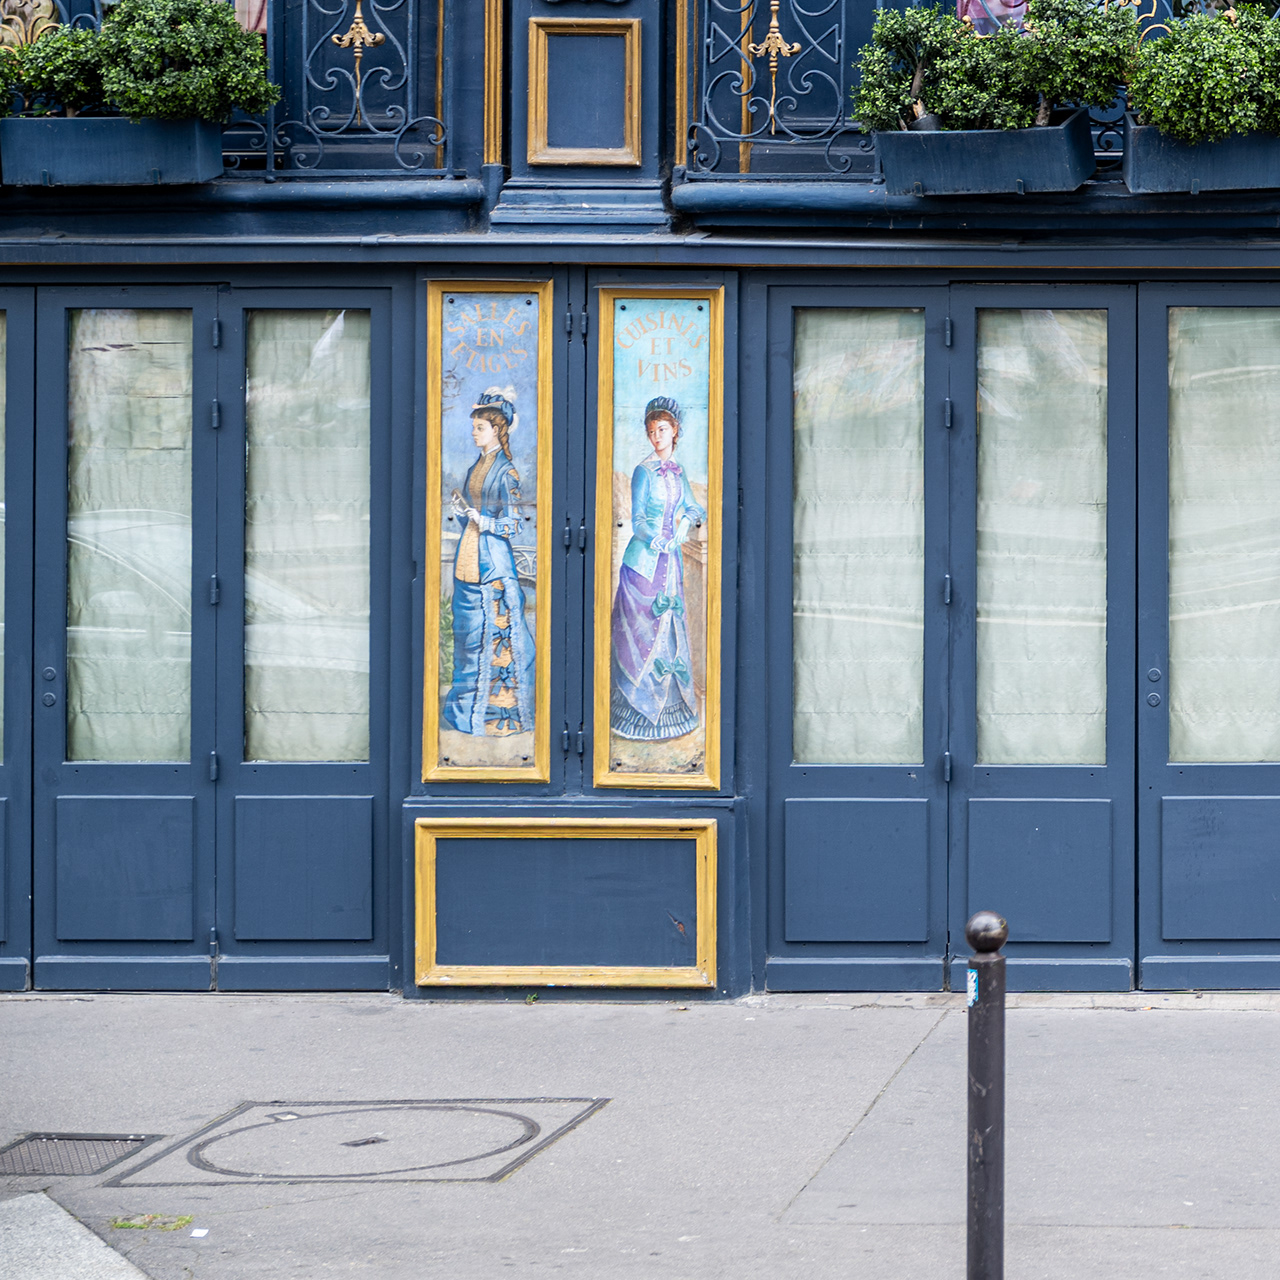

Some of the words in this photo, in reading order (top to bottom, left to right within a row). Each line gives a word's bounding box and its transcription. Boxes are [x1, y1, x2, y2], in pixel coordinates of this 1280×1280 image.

[447, 302, 532, 338] SALLES
[616, 311, 708, 349] CUISINES
[476, 327, 505, 347] EN
[650, 337, 676, 355] ET
[450, 341, 528, 373] ETAGES
[638, 358, 692, 382] VINS
